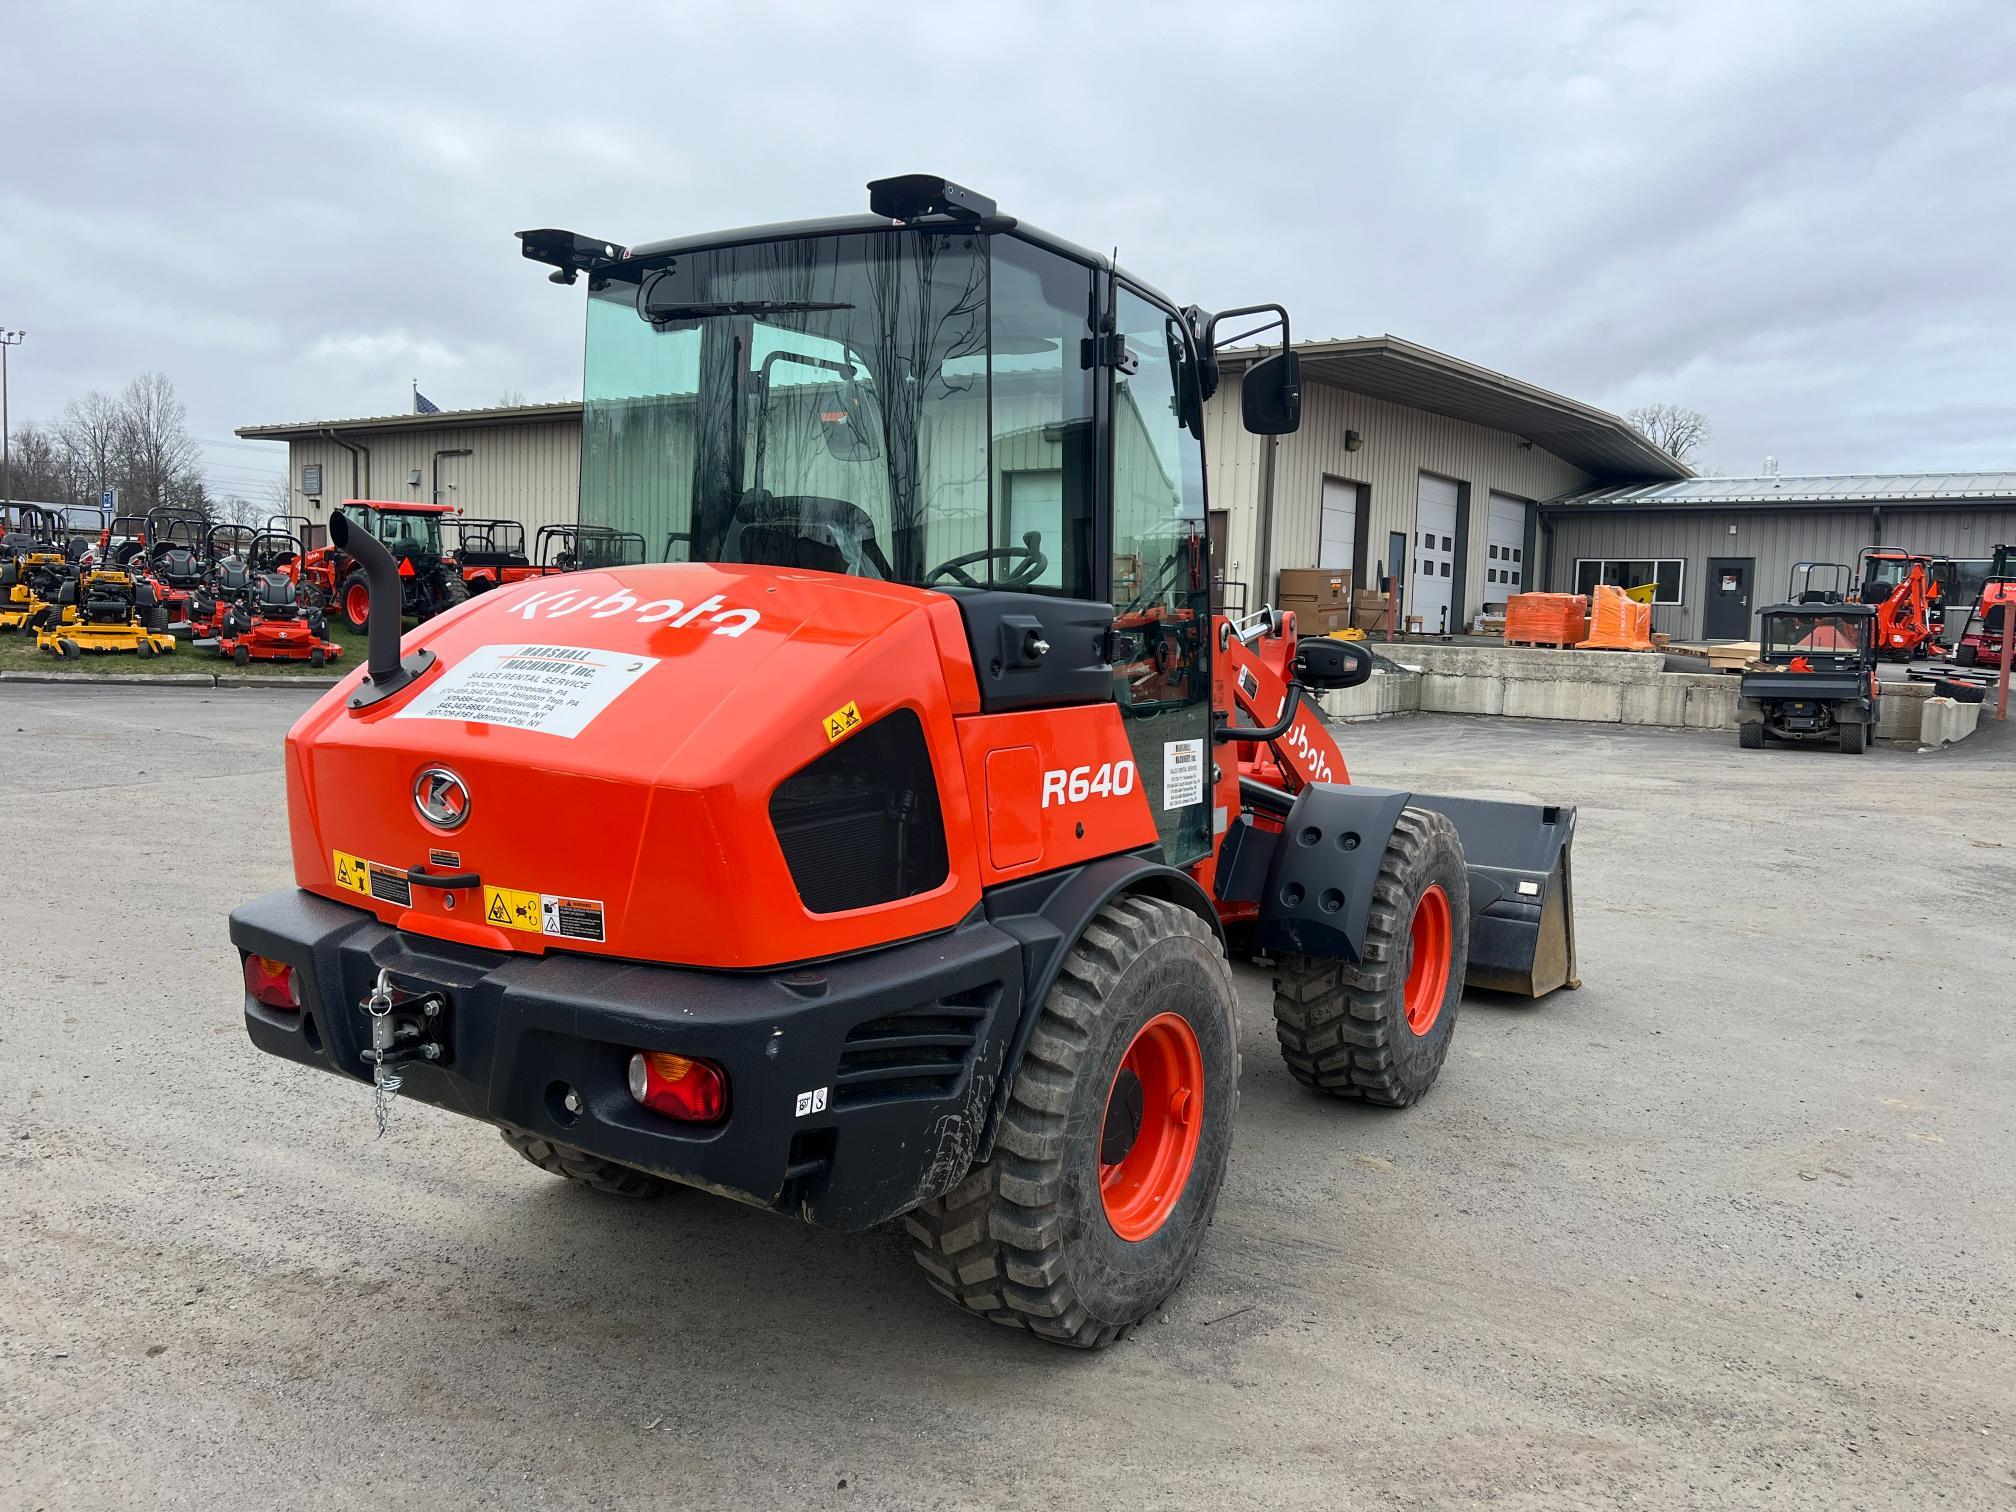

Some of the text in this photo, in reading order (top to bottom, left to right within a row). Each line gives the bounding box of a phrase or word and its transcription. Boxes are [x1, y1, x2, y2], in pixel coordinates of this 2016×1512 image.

[506, 588, 761, 638] Kubota
[520, 647, 591, 661] MARSHALL
[502, 660, 596, 678] MACHINERY, Inc.
[468, 672, 592, 690] SALES RENTAL SERVICE
[486, 689, 510, 697] South
[565, 699, 580, 708] PA
[554, 689, 568, 697] PA
[531, 711, 548, 719] NY
[541, 704, 555, 712] PA
[472, 713, 508, 722] Johnson
[526, 719, 543, 728] NY
[1042, 760, 1134, 809] R640
